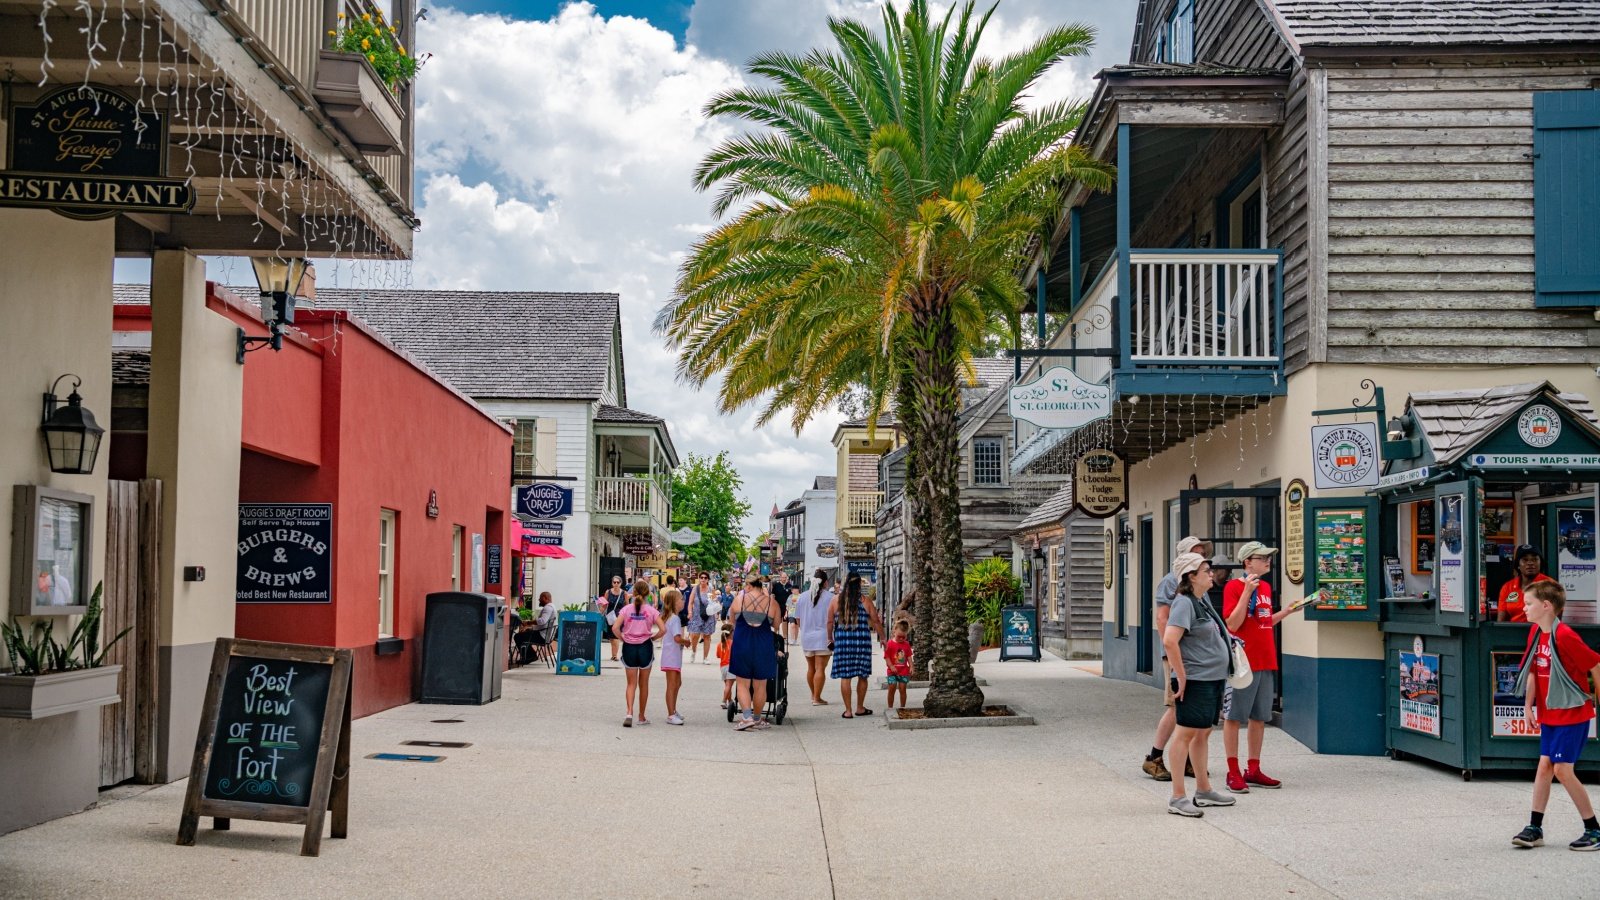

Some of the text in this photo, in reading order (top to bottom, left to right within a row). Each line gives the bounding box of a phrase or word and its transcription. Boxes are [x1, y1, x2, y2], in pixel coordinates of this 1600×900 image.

[31, 90, 127, 128] ST. AUGUSTINE
[56, 135, 121, 172] George
[1020, 402, 1101, 411] ST. GEORGE INN
[1520, 408, 1559, 429] OLD TOWN TROLLEY
[1319, 430, 1372, 460] OLD TOWN TROLLEY
[1526, 435, 1554, 445] TOURS
[1328, 465, 1367, 482] TOURS
[523, 487, 564, 501] AUGGIE'S
[1092, 485, 1113, 494] Fudge
[531, 499, 559, 512] DRAFT
[1085, 494, 1120, 503] Ice Cream
[238, 507, 328, 519] AUGGIE'S DRAFT ROOM
[237, 529, 327, 556] BURGERS
[273, 547, 288, 563] &
[244, 565, 317, 586] BREWS
[236, 590, 327, 599] oted Best New Restaurant
[246, 664, 298, 696] Best
[244, 692, 295, 716] View
[1420, 703, 1438, 718] TICKETS
[1495, 707, 1524, 717] GHOSTS
[1406, 712, 1433, 732] SOLD HERE
[229, 722, 297, 744] OF THE
